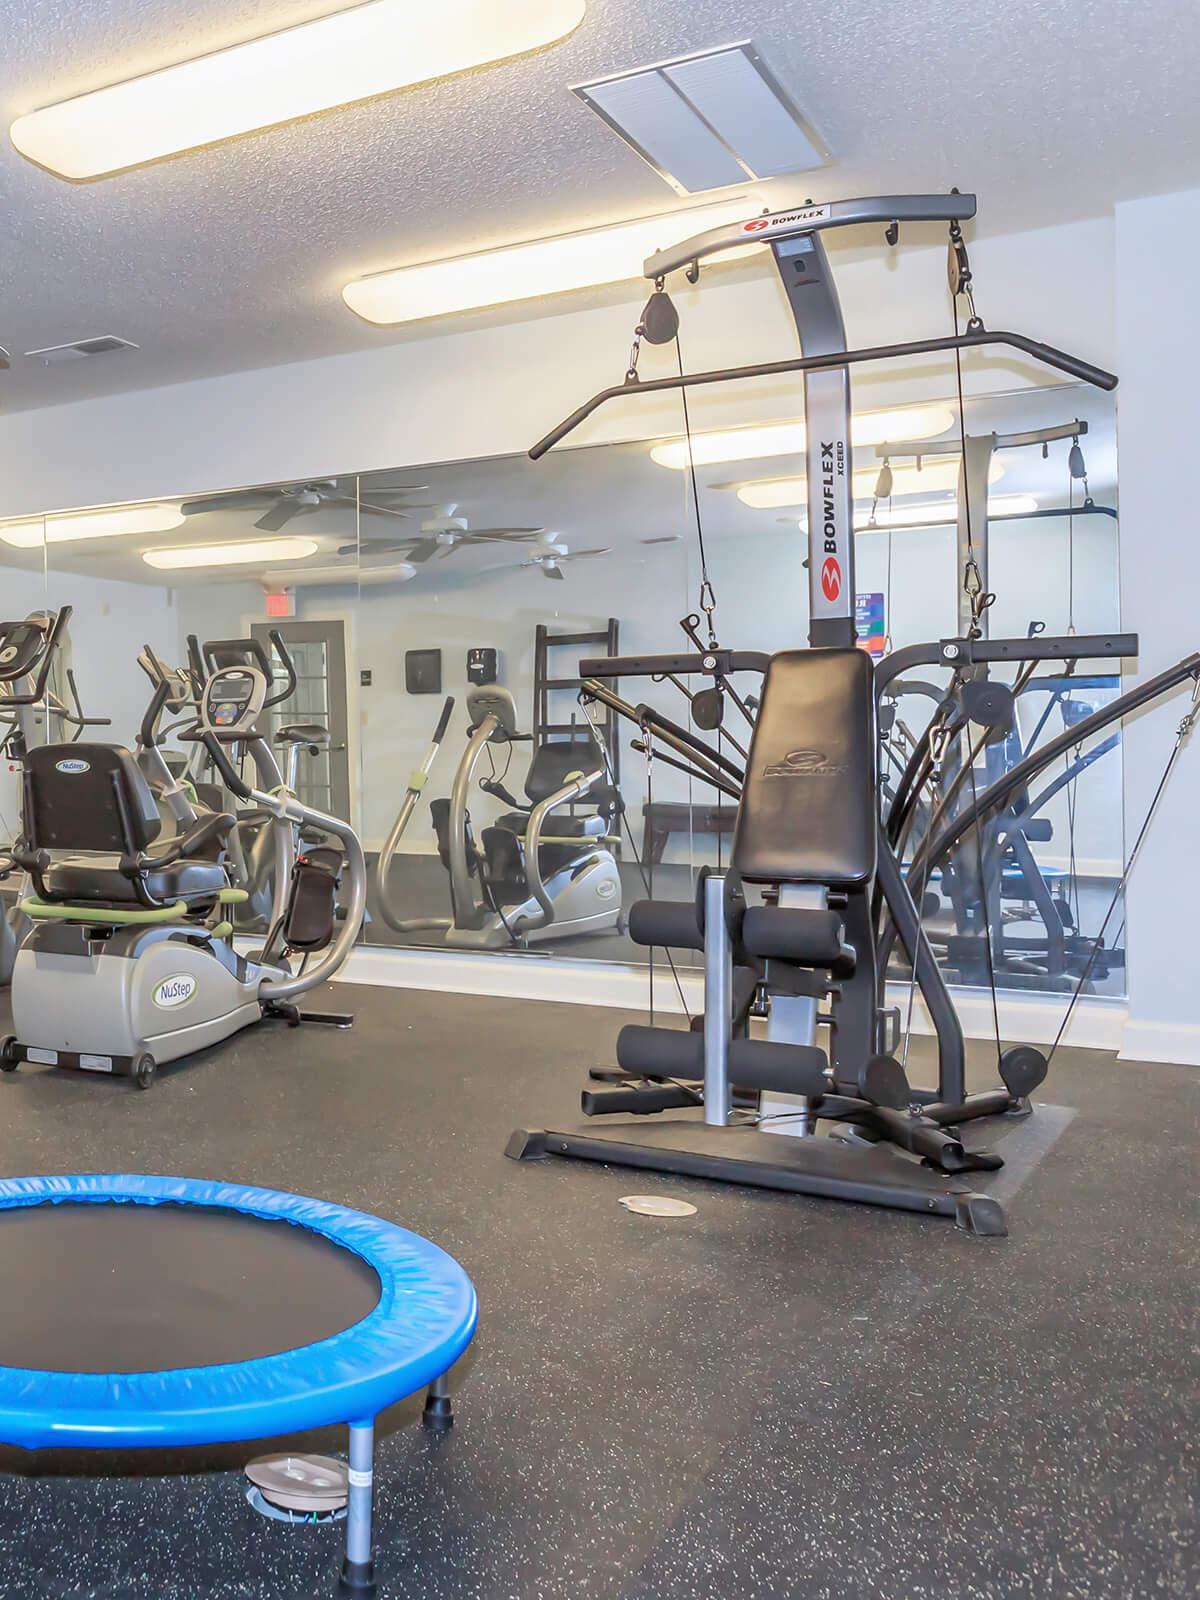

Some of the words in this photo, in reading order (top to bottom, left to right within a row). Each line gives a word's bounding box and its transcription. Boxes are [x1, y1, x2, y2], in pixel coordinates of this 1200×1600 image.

[772, 209, 824, 226] BOWFLEX
[836, 441, 844, 476] XCEED
[820, 441, 837, 554] BOWFLEX
[160, 982, 191, 1000] NuStep
